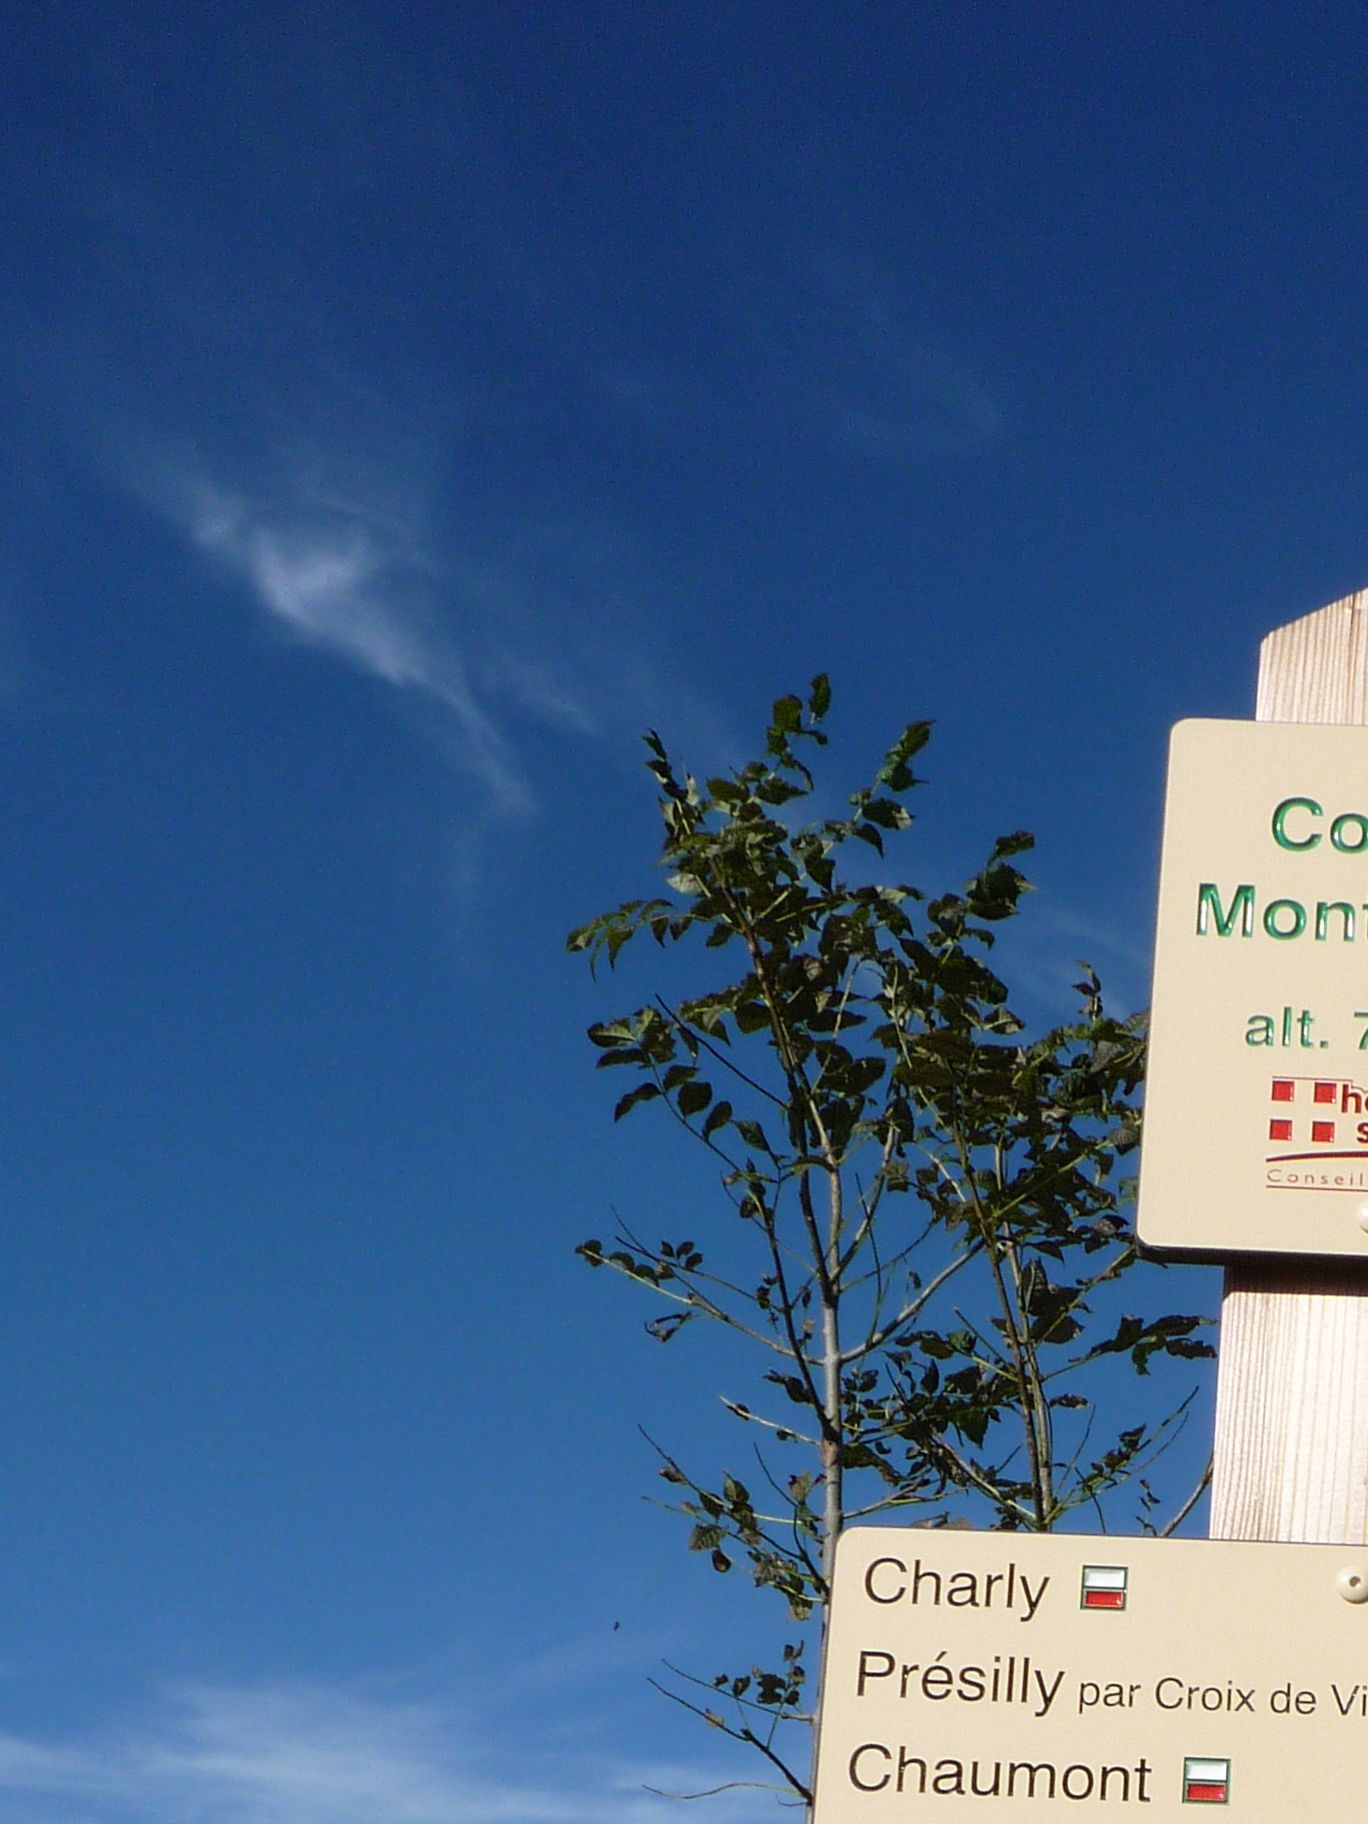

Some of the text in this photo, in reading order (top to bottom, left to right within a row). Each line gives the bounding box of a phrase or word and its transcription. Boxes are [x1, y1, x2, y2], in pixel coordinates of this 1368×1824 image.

[1245, 1007, 1328, 1048] alt.
[1267, 1169, 1364, 1185] Conseil
[865, 1557, 1050, 1622] Charly
[857, 1651, 1065, 1717] Présilly
[1079, 1683, 1141, 1714] par
[1155, 1677, 1255, 1712] Croix
[1270, 1683, 1316, 1714] de
[849, 1744, 1152, 1802] Chaumont
